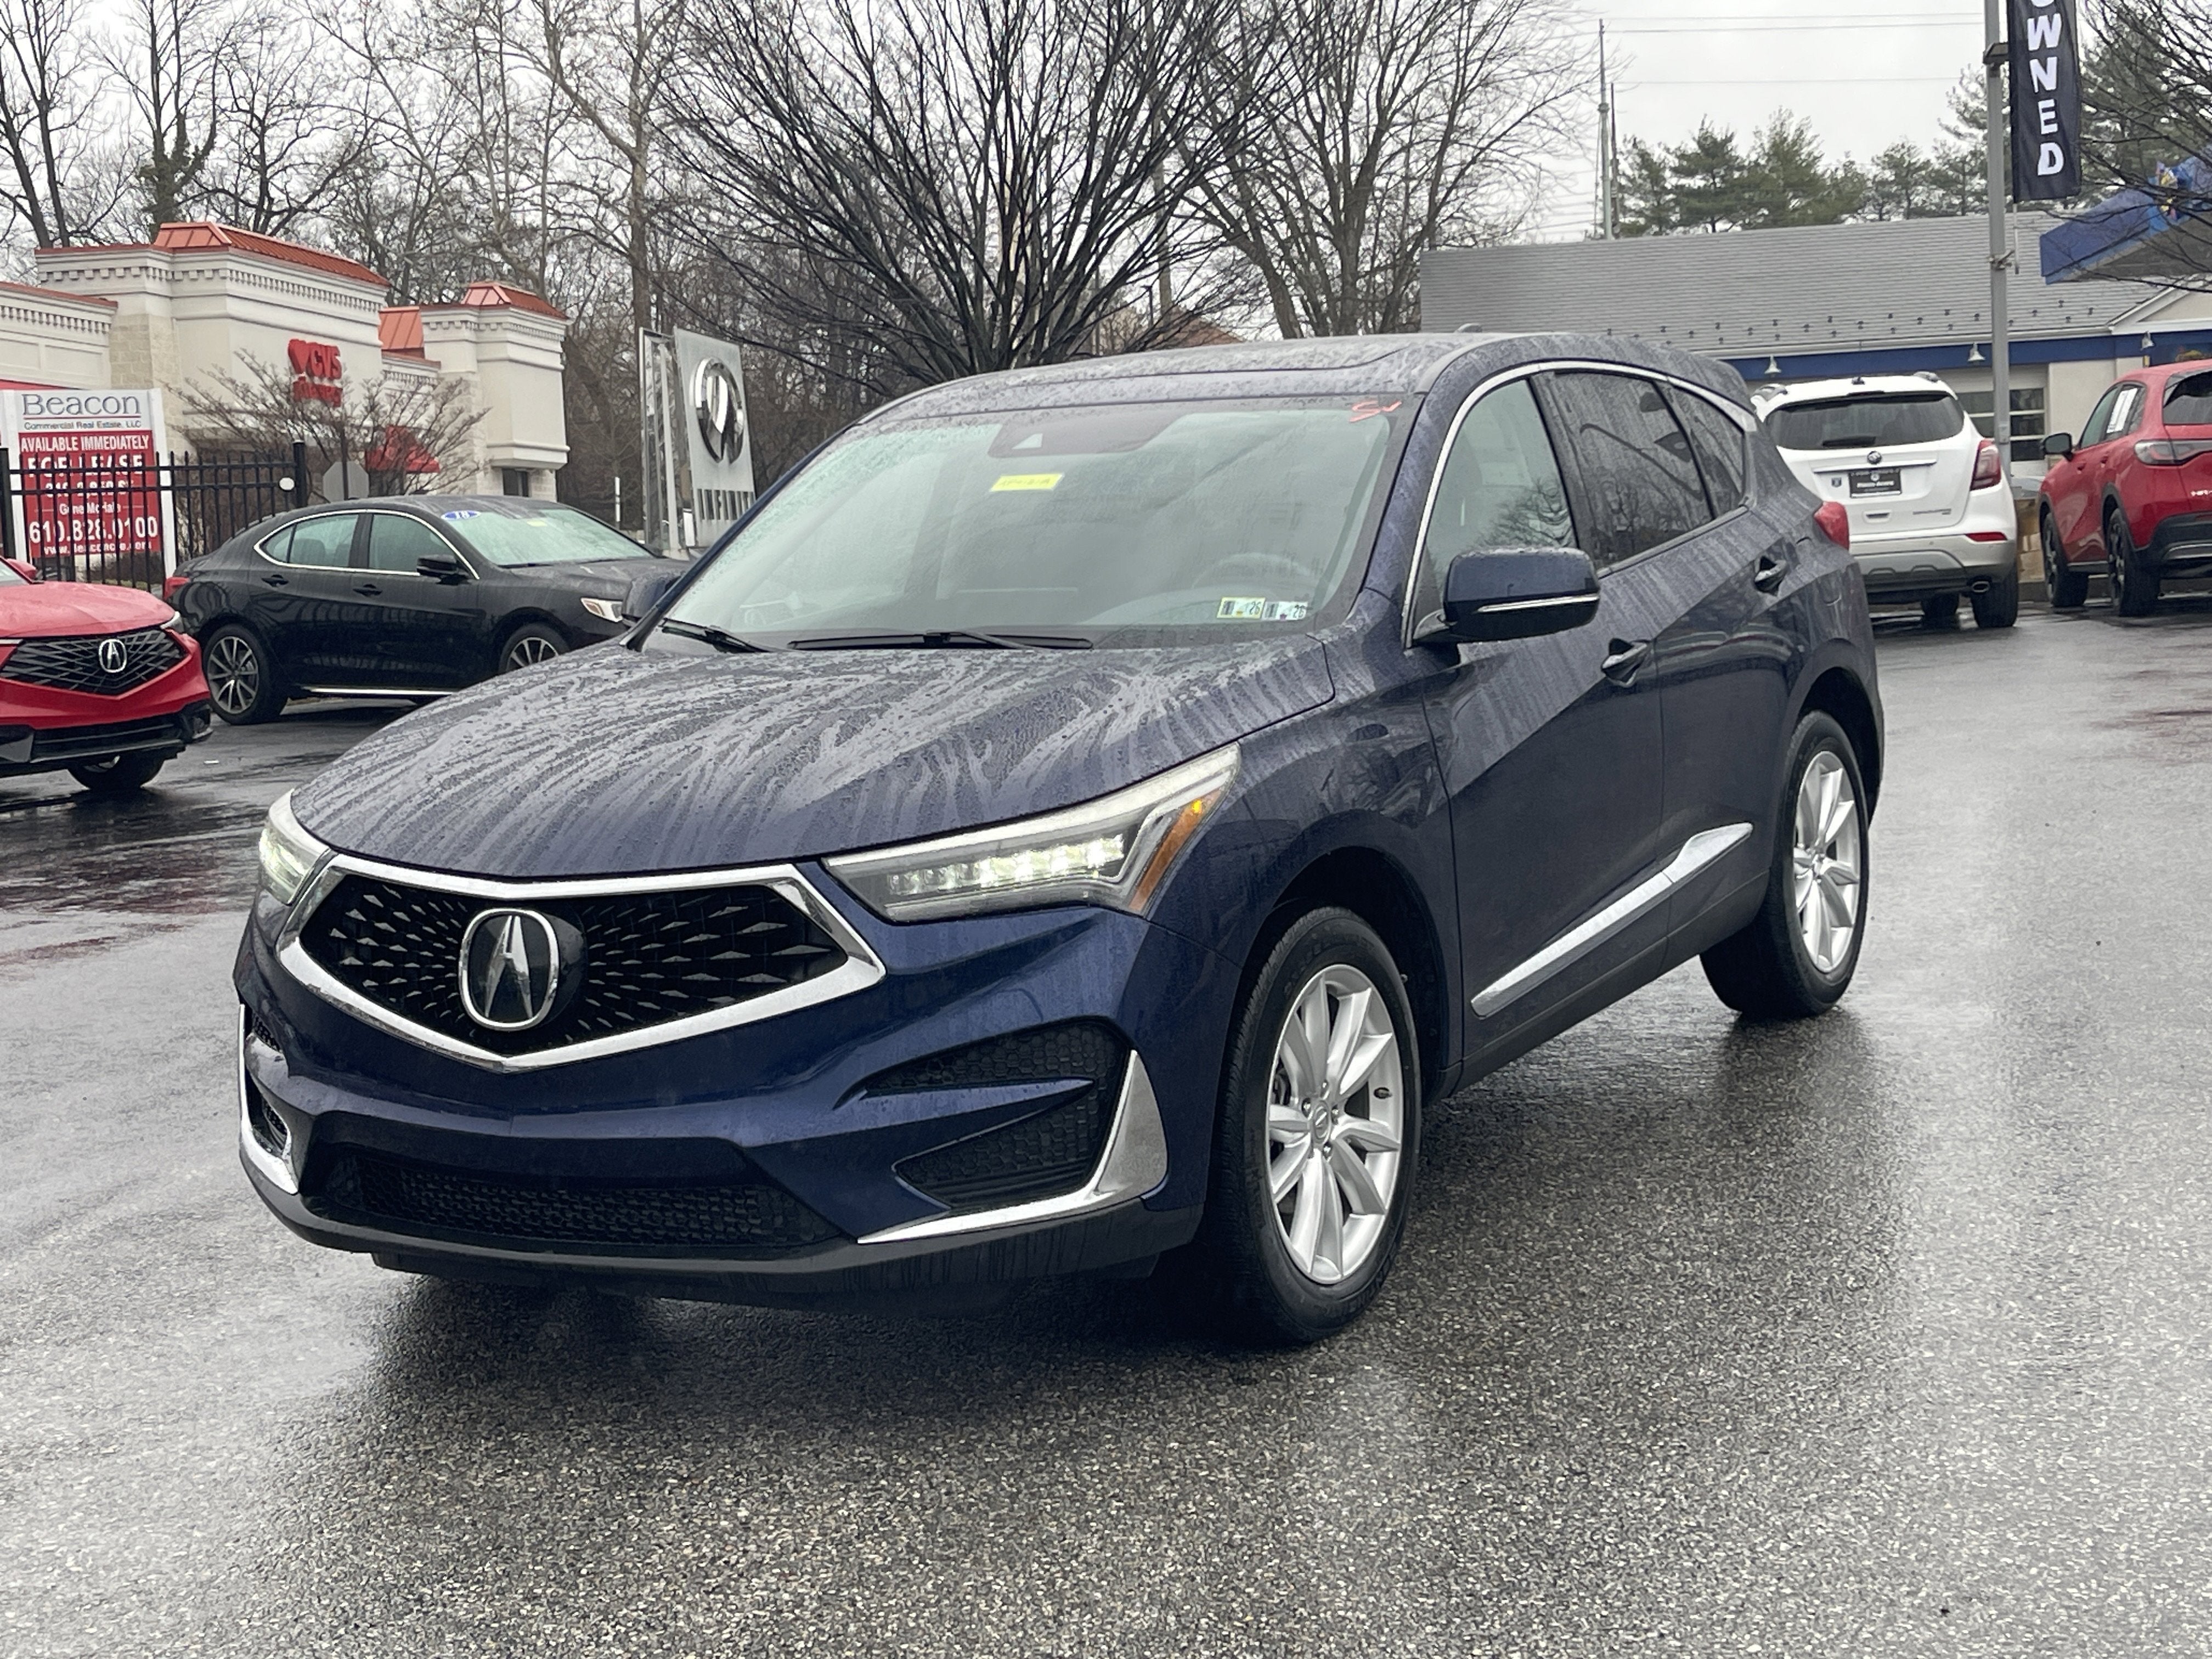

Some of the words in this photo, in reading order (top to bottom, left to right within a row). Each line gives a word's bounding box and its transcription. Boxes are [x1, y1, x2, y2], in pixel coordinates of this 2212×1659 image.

[2027, 0, 2064, 176] WNED
[306, 342, 342, 380] CVS
[21, 393, 141, 416] Beacon
[24, 421, 74, 430] Commercial
[126, 420, 141, 428] LLC
[21, 437, 78, 453] AVAILABLE
[81, 435, 149, 451] IMMEDIATELY
[29, 516, 158, 543] 610.828.0100
